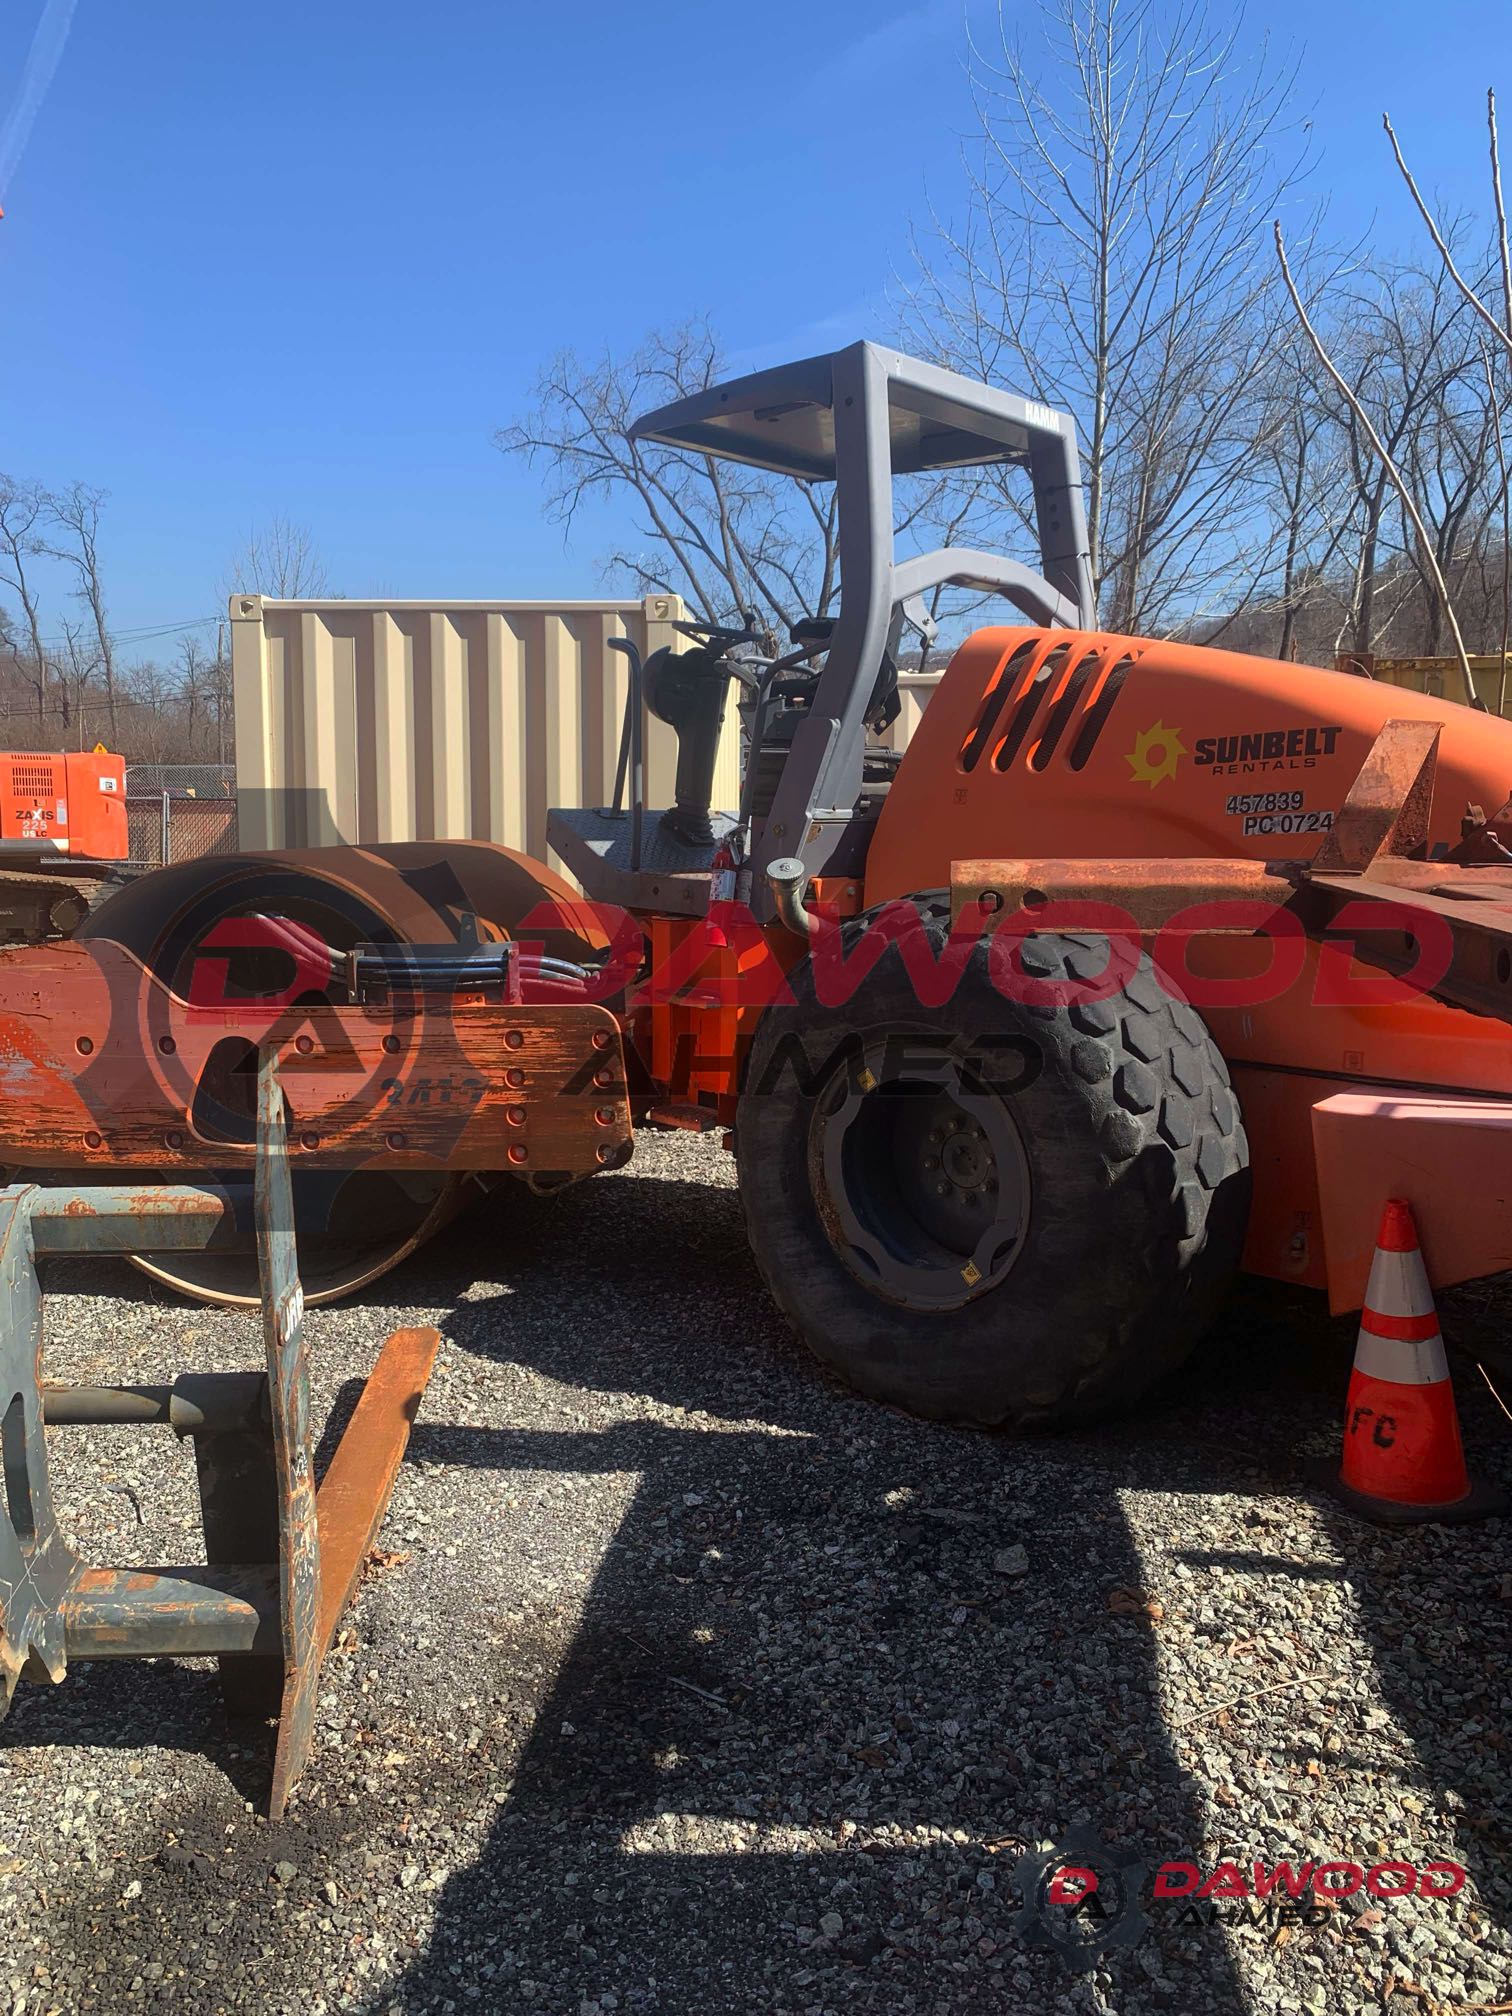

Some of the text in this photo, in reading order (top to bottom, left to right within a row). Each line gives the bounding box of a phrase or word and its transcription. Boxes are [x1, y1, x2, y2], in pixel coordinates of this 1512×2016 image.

[1194, 727, 1342, 765] SUNBELT
[1212, 758, 1317, 775] RENTALS
[1227, 791, 1303, 813] 457839
[15, 808, 54, 820] ZAXIS
[22, 820, 47, 830] 225
[1244, 813, 1333, 835] PC 0724
[22, 830, 47, 838] USLC
